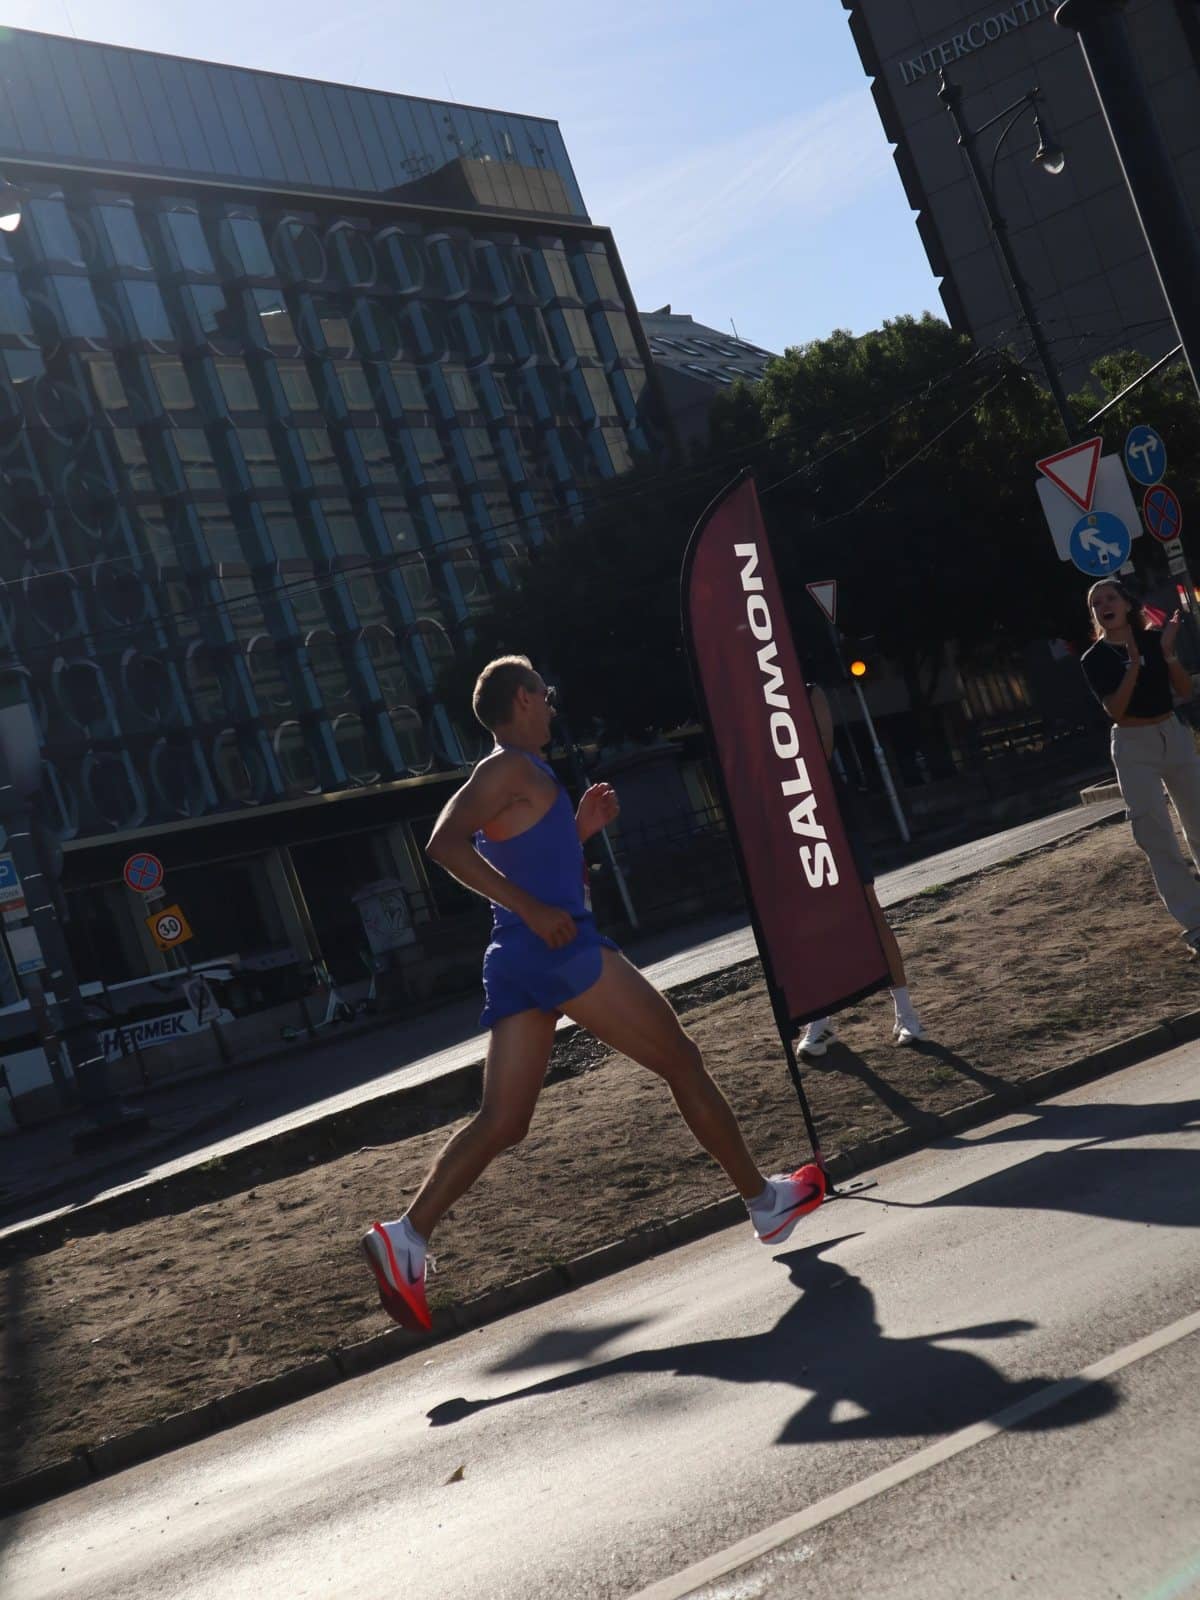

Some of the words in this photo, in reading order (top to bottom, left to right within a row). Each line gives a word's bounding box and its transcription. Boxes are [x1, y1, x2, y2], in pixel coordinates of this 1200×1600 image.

[733, 542, 839, 889] SALOMON
[160, 919, 178, 937] 30
[103, 1015, 188, 1057] HERMEK
